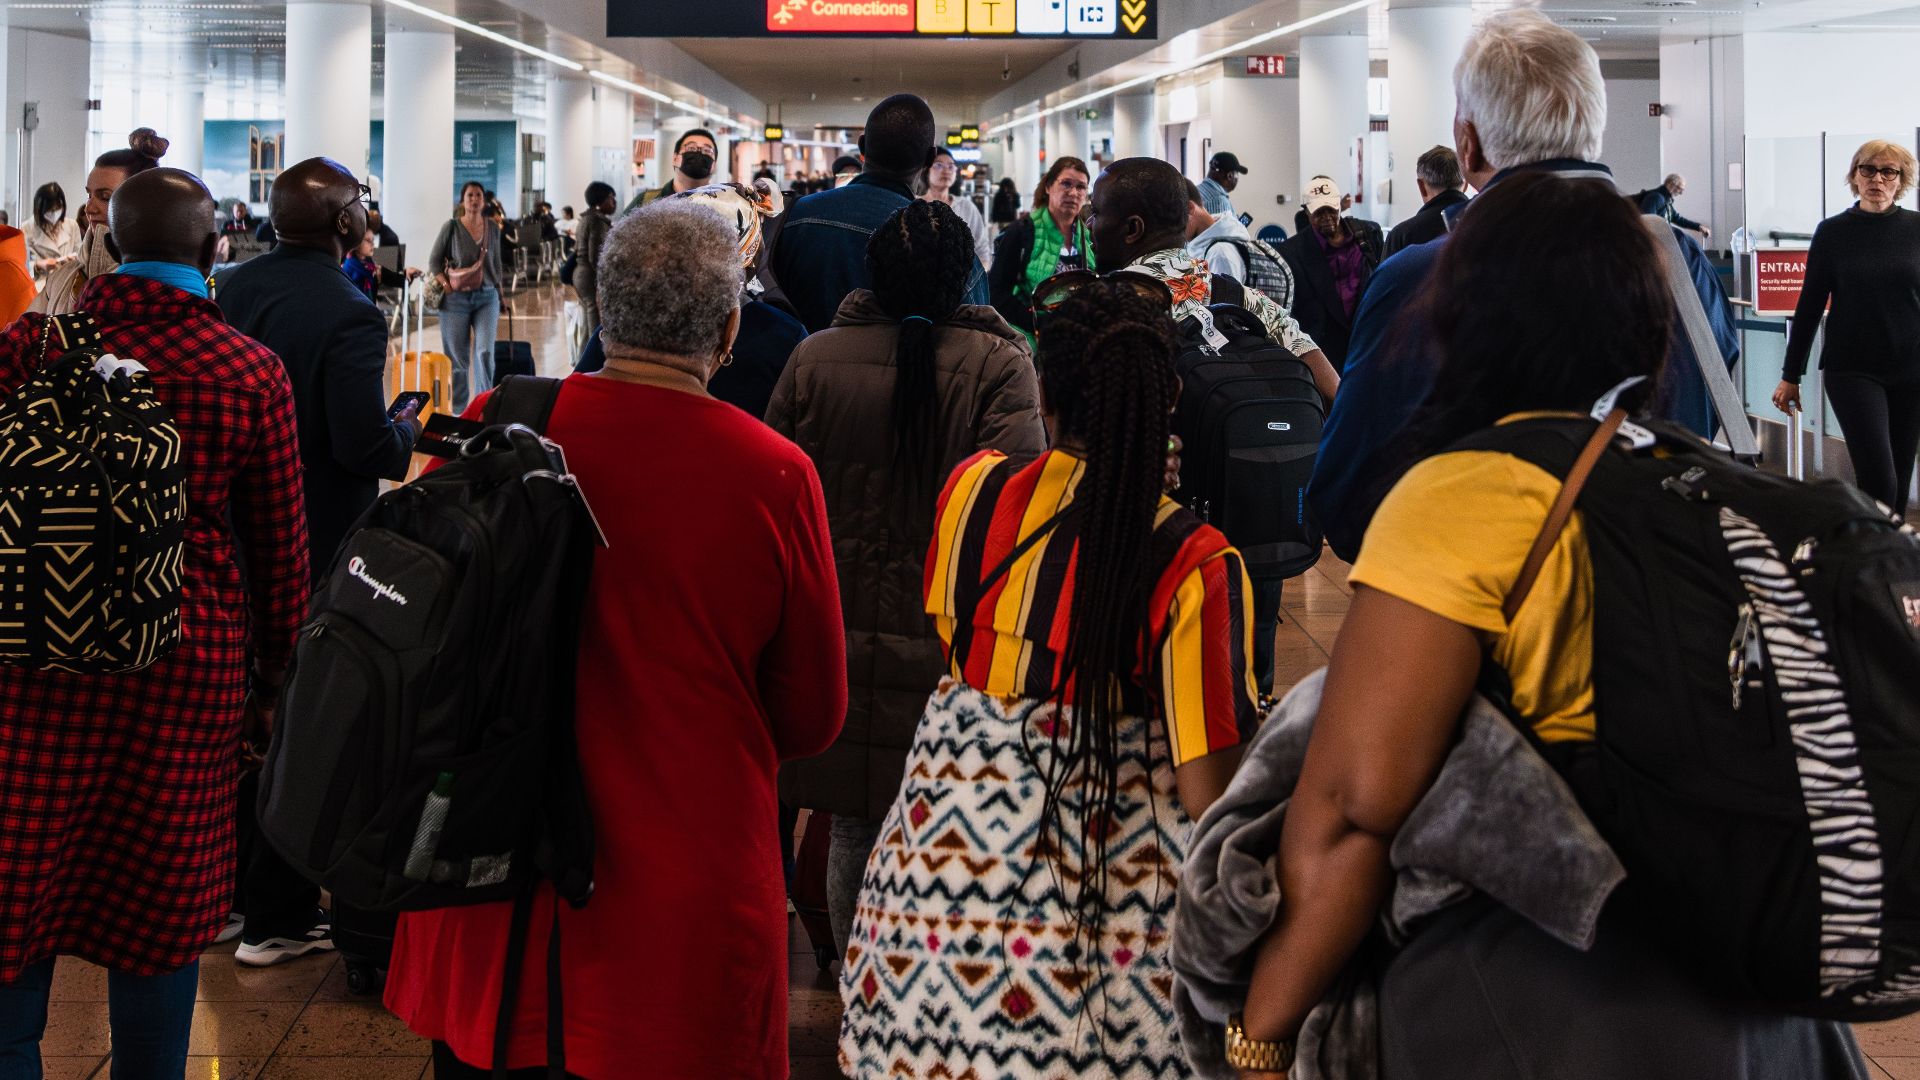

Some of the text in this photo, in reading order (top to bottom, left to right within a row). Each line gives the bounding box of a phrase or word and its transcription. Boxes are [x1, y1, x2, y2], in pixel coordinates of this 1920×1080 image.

[811, 0, 1001, 26] Connections B T
[348, 555, 408, 606] Champion
